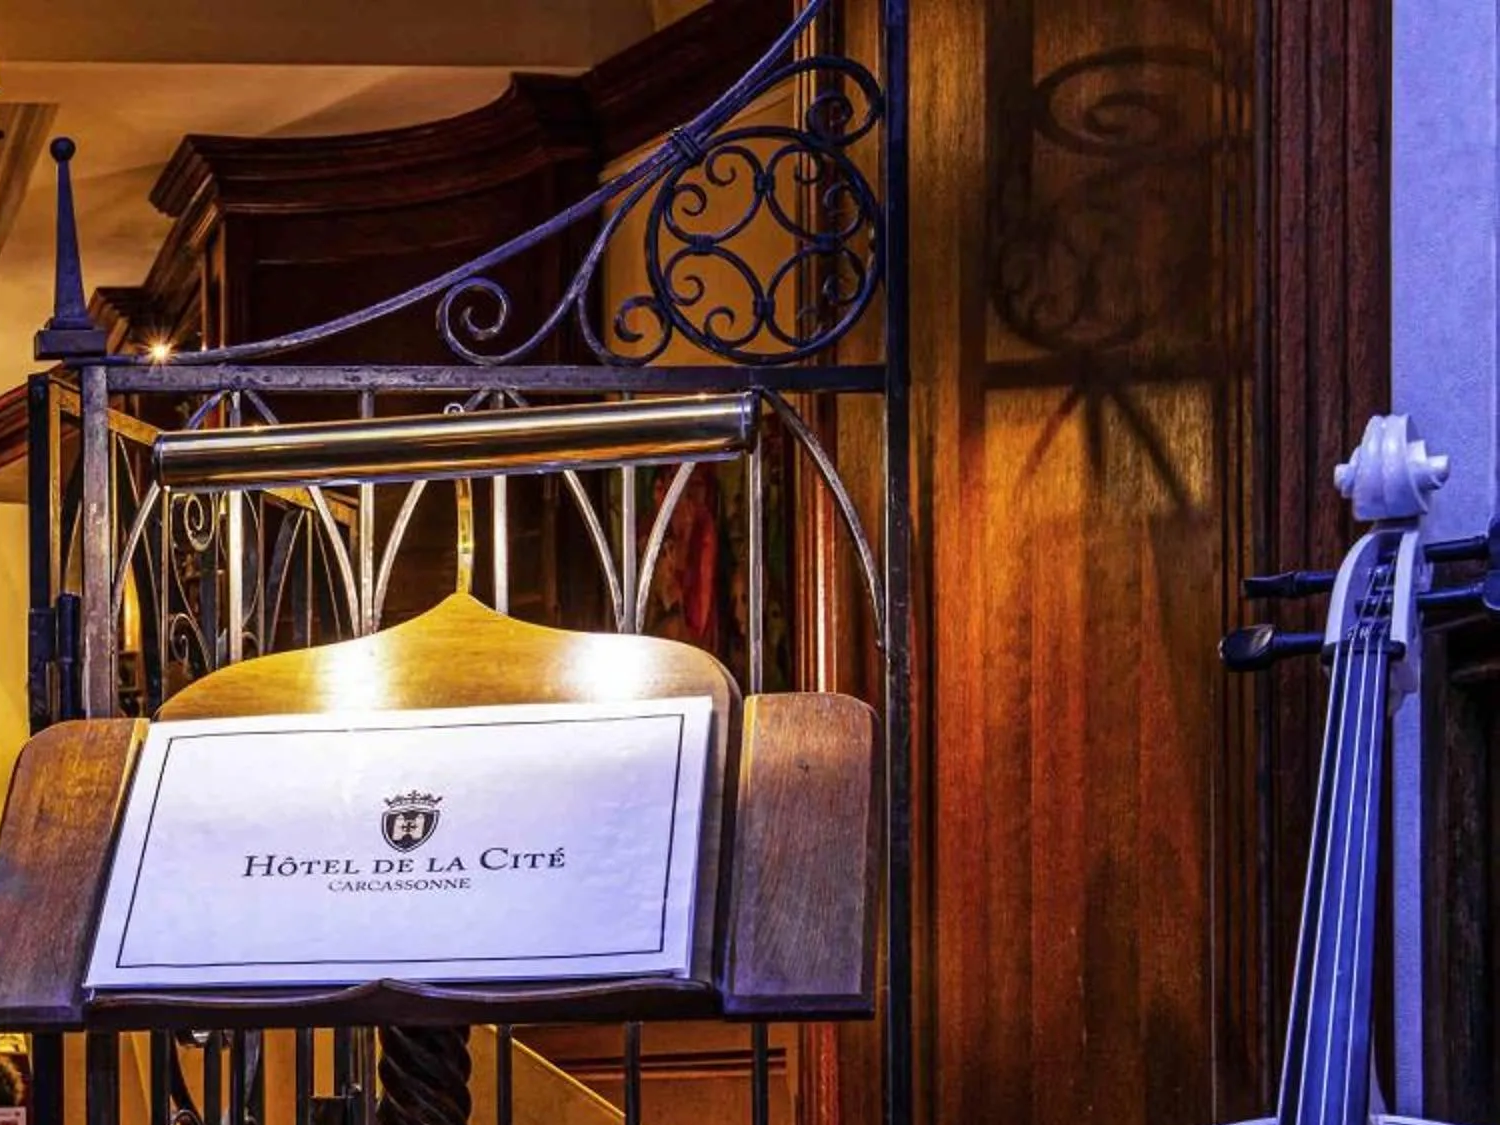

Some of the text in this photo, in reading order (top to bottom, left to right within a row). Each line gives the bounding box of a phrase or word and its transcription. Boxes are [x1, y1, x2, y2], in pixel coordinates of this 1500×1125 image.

[242, 845, 566, 877] HÔTEL DE LA CITÉ
[328, 878, 472, 893] CARCASSONNE
